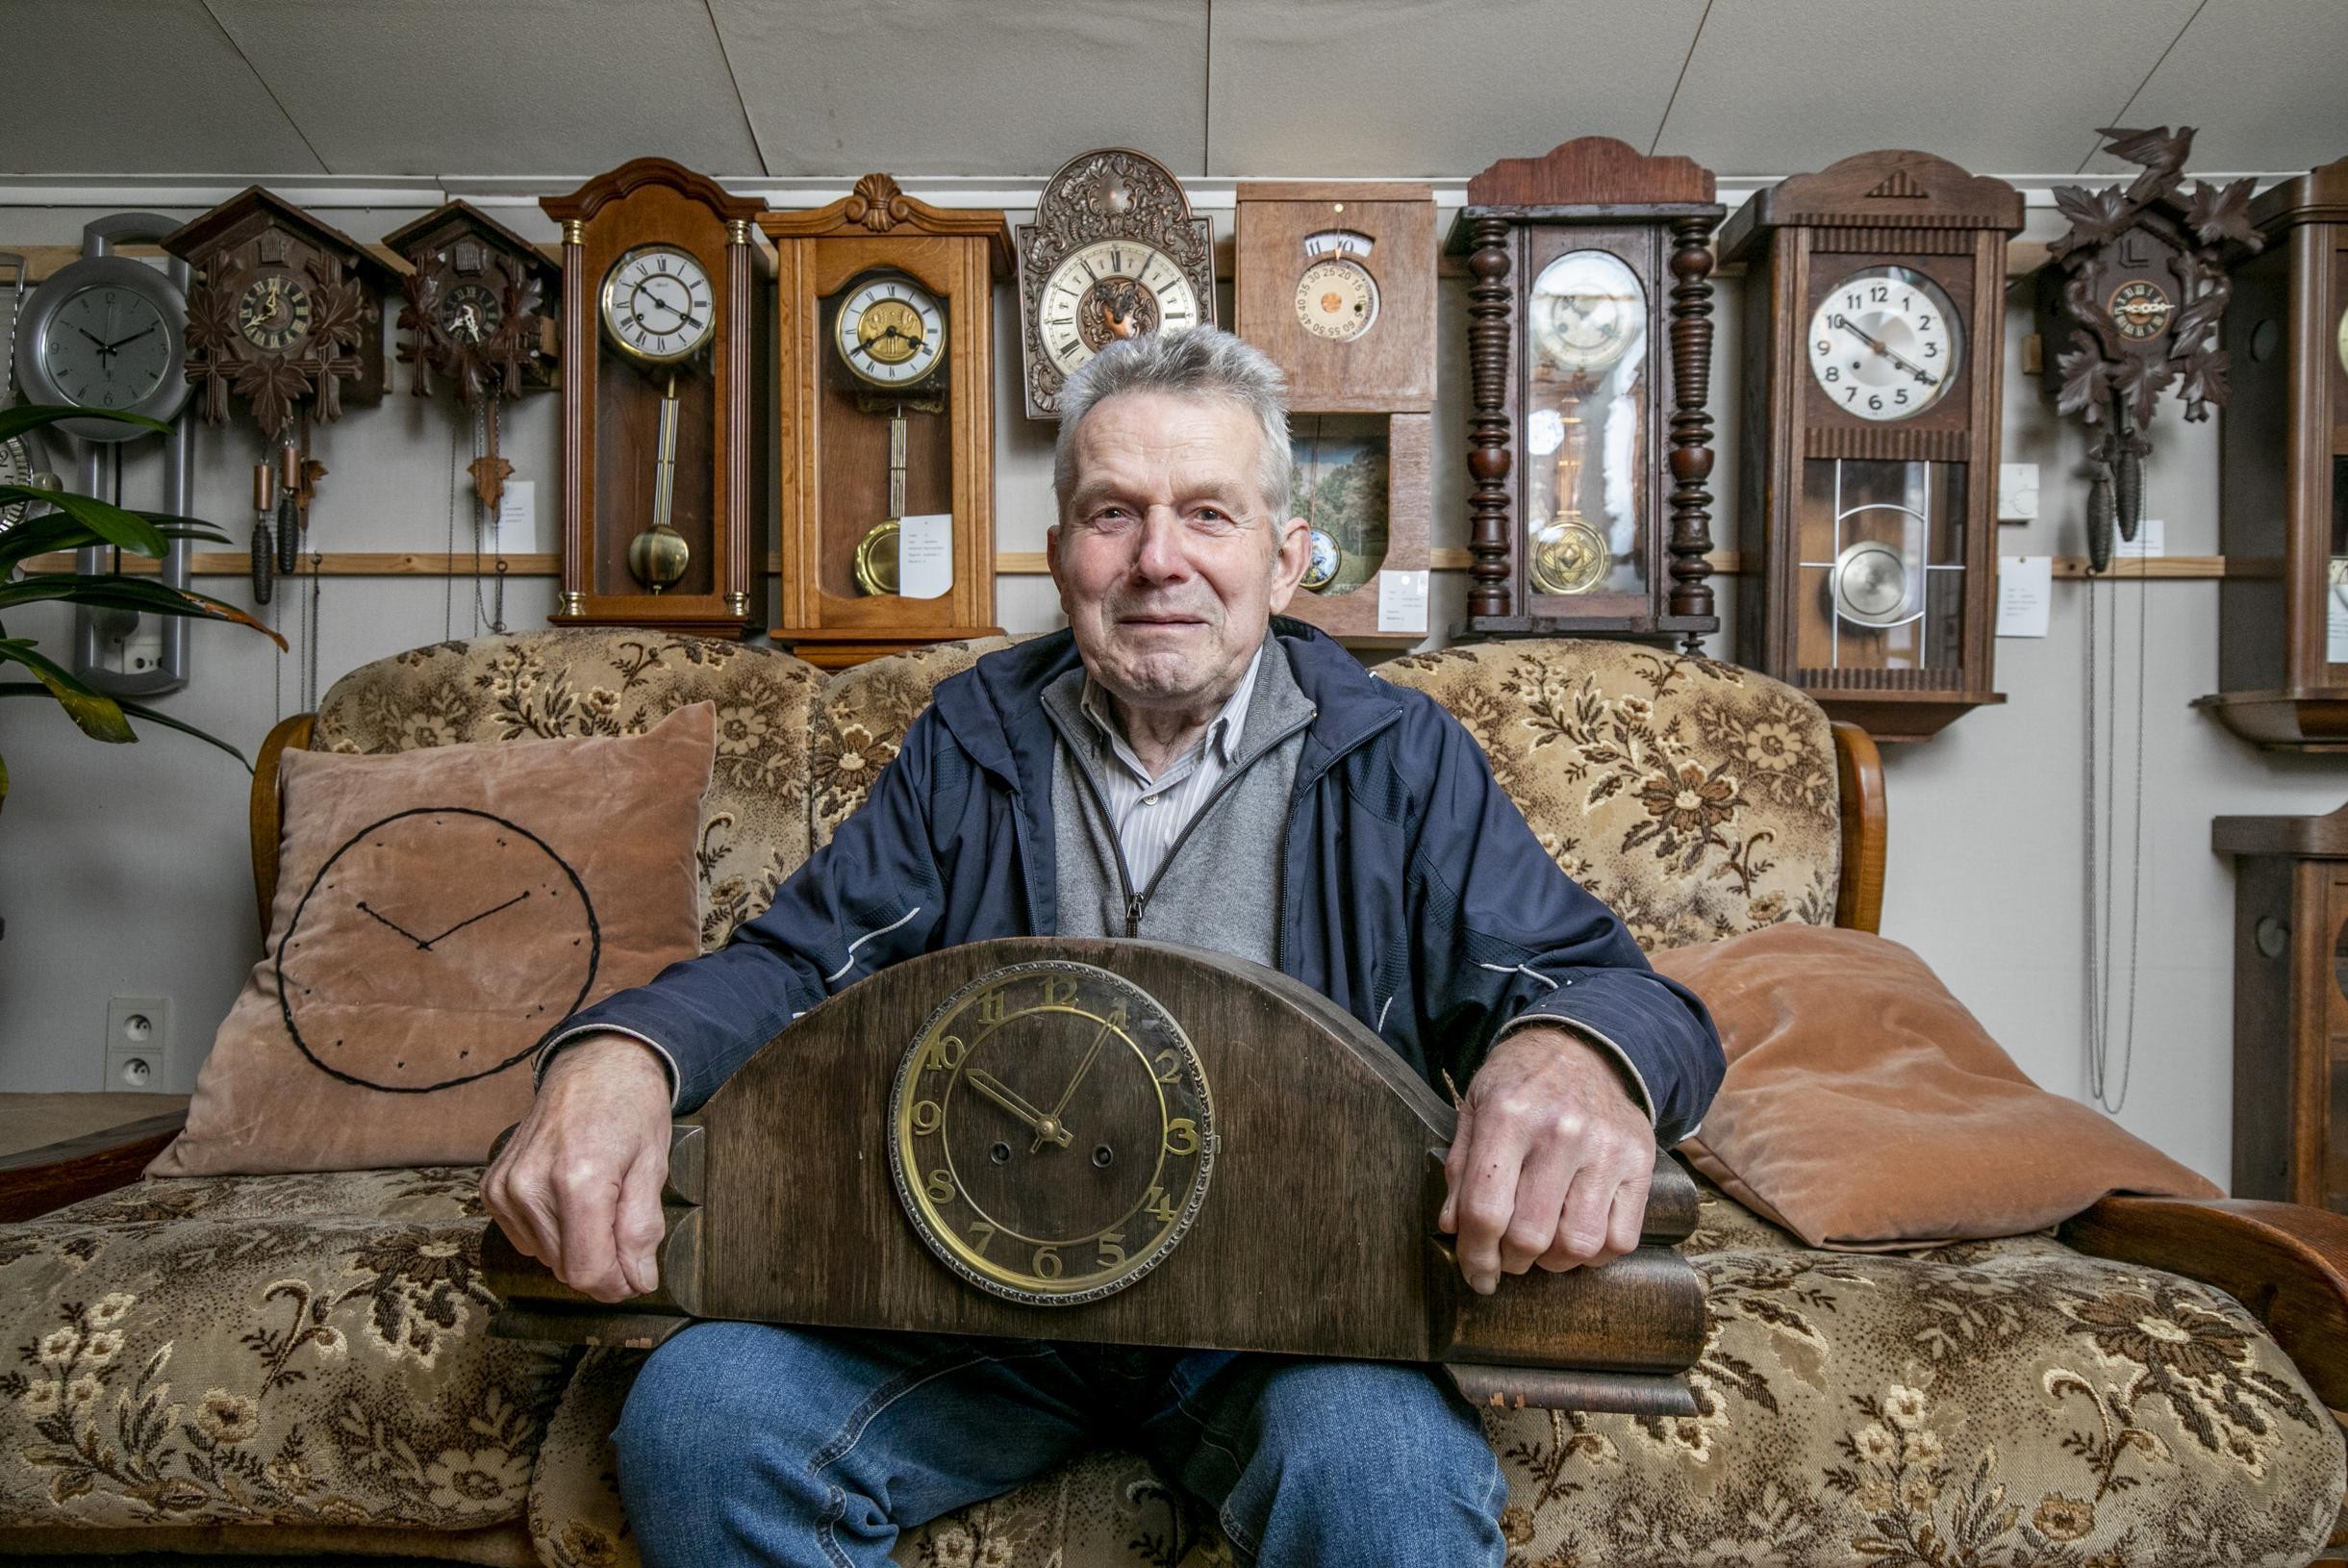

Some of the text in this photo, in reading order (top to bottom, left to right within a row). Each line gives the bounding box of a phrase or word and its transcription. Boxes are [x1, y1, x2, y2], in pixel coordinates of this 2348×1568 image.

[1309, 239, 1322, 256] 11
[1307, 271, 1321, 284] 30
[1323, 268, 1336, 278] 25
[1338, 268, 1351, 281] 20
[1299, 283, 1311, 296] 35
[1351, 279, 1364, 291] 15
[1846, 294, 1863, 310] 11
[1870, 287, 1889, 303] 12
[1297, 298, 1306, 312] 40
[1903, 296, 1910, 312] 1
[1300, 313, 1312, 325] 45
[1343, 320, 1355, 332] 60
[1827, 313, 1844, 330] 10
[1918, 315, 1931, 331] 2
[1312, 322, 1325, 335] 50
[1327, 327, 1341, 337] 55
[51, 341, 60, 354] 9
[1817, 340, 1831, 356] 9
[1924, 341, 1938, 358] 3
[1825, 367, 1839, 383] 8
[104, 391, 113, 405] 6
[1845, 387, 1858, 403] 7
[1868, 394, 1882, 411] 6
[1894, 388, 1908, 405] 5
[1037, 974, 1079, 1008] 12
[976, 987, 1005, 1025] 11
[1111, 997, 1130, 1030] 1
[925, 1033, 966, 1071] 10
[1154, 1048, 1183, 1084] 2
[910, 1100, 942, 1137] 9
[1165, 1118, 1199, 1155] 3
[925, 1169, 956, 1204] 8
[1144, 1186, 1178, 1223] 4
[968, 1221, 997, 1256] 7
[1097, 1232, 1126, 1269] 5
[1032, 1246, 1063, 1280] 6
